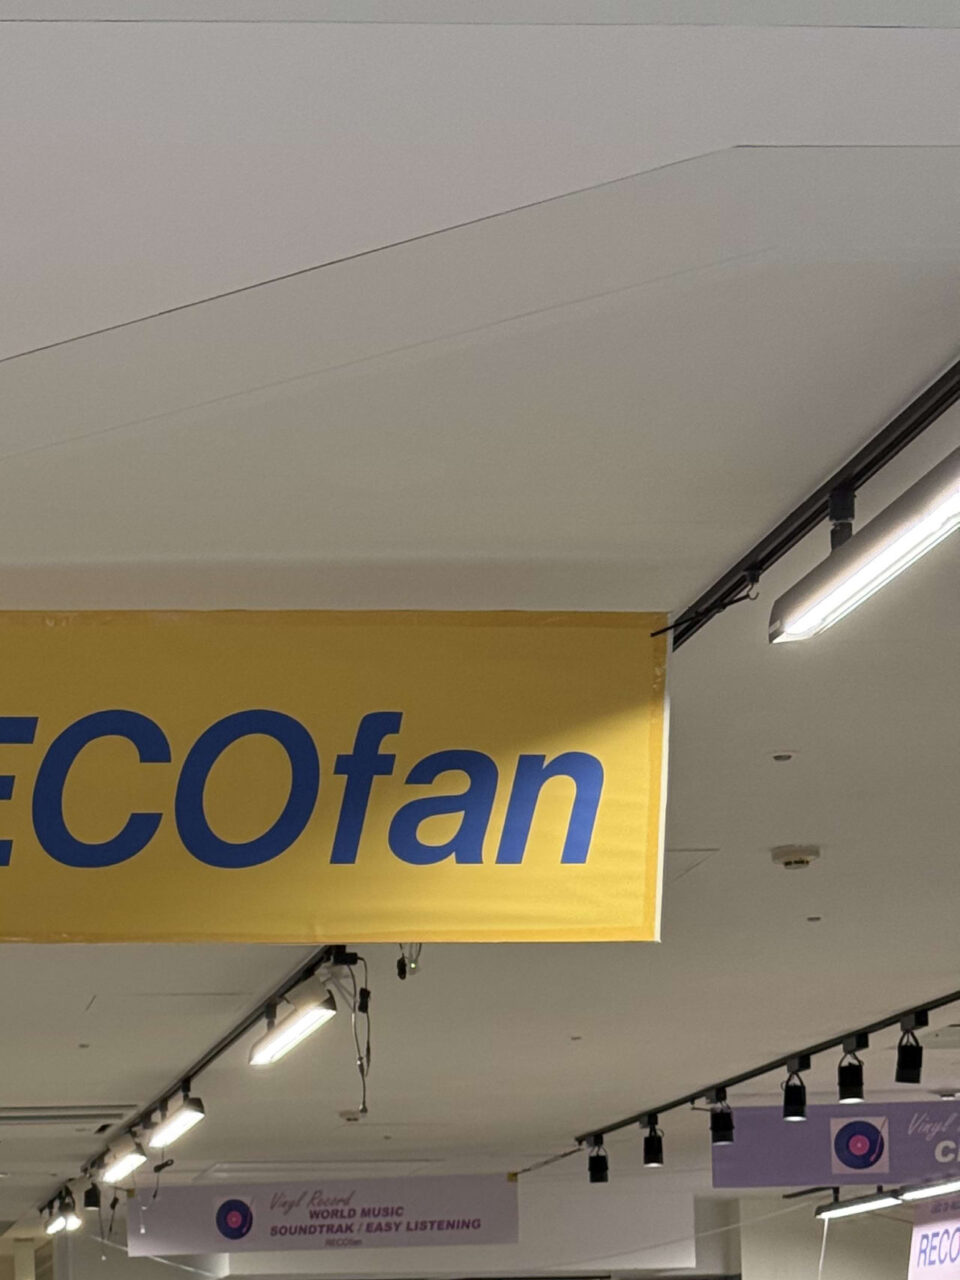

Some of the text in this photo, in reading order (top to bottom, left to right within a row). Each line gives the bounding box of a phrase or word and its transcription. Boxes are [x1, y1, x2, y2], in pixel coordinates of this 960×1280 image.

[309, 1206, 404, 1220] WORLD MUSIC
[270, 1222, 354, 1236] SOUNDTRAK
[365, 1221, 402, 1234] EASY
[406, 1218, 481, 1232] LISTENING
